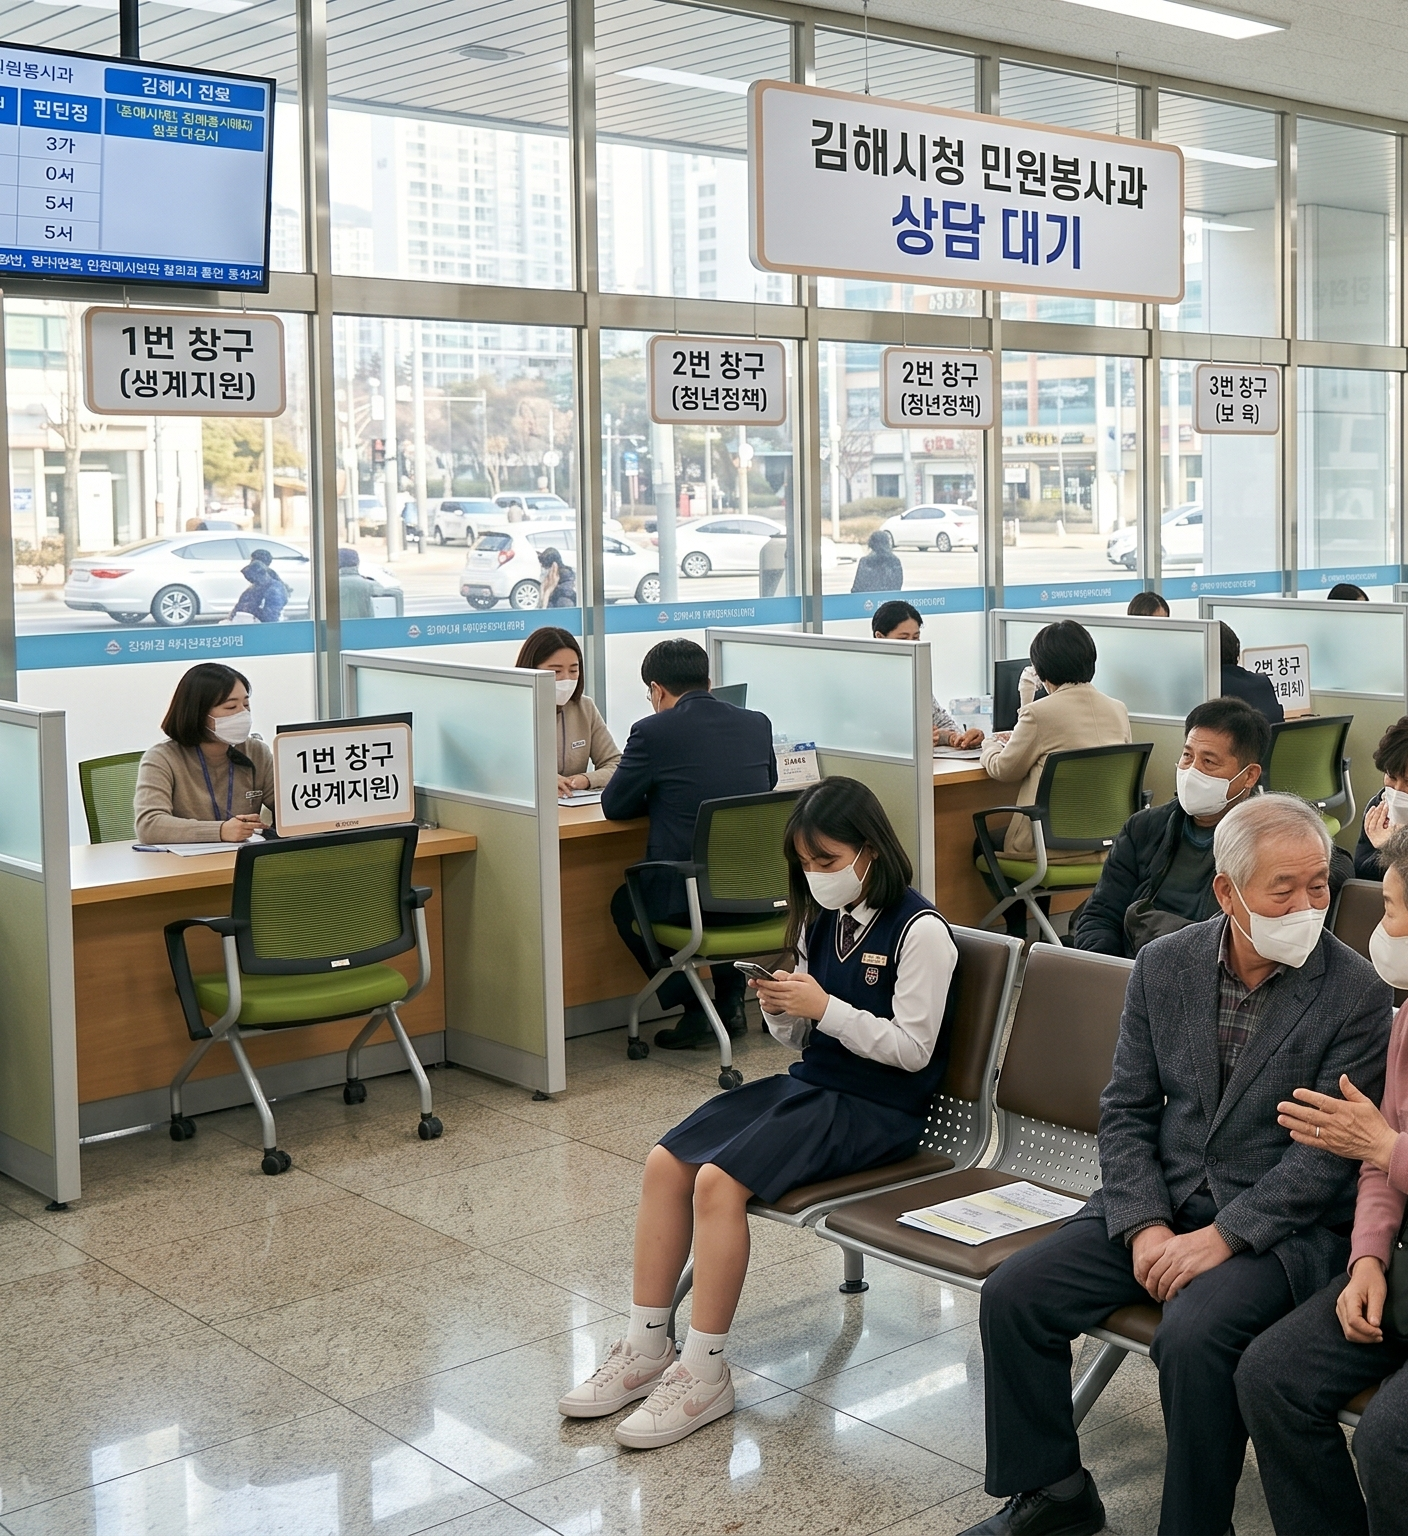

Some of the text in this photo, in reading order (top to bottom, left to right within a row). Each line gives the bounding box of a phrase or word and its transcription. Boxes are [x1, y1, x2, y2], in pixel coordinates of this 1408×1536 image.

[46, 136, 75, 155] 3가
[810, 118, 1148, 210] 김해시청 민원봉사과
[45, 196, 73, 213] 5서
[44, 225, 73, 242] 5서
[891, 194, 1082, 271] 상담 대기
[121, 325, 254, 363] 1번 창구
[672, 350, 766, 380] 2번 창구
[902, 360, 979, 389] 2번 창구
[120, 367, 256, 402] (생계지원)
[671, 385, 768, 412] (청년정책)
[1209, 375, 1268, 399] 3번 창구
[900, 392, 982, 418] (청년정책)
[1215, 402, 1260, 425] (보 육)
[1254, 656, 1301, 677] 2번 창구
[296, 741, 394, 775] 1번 창구
[291, 773, 400, 811] (생계지원)
